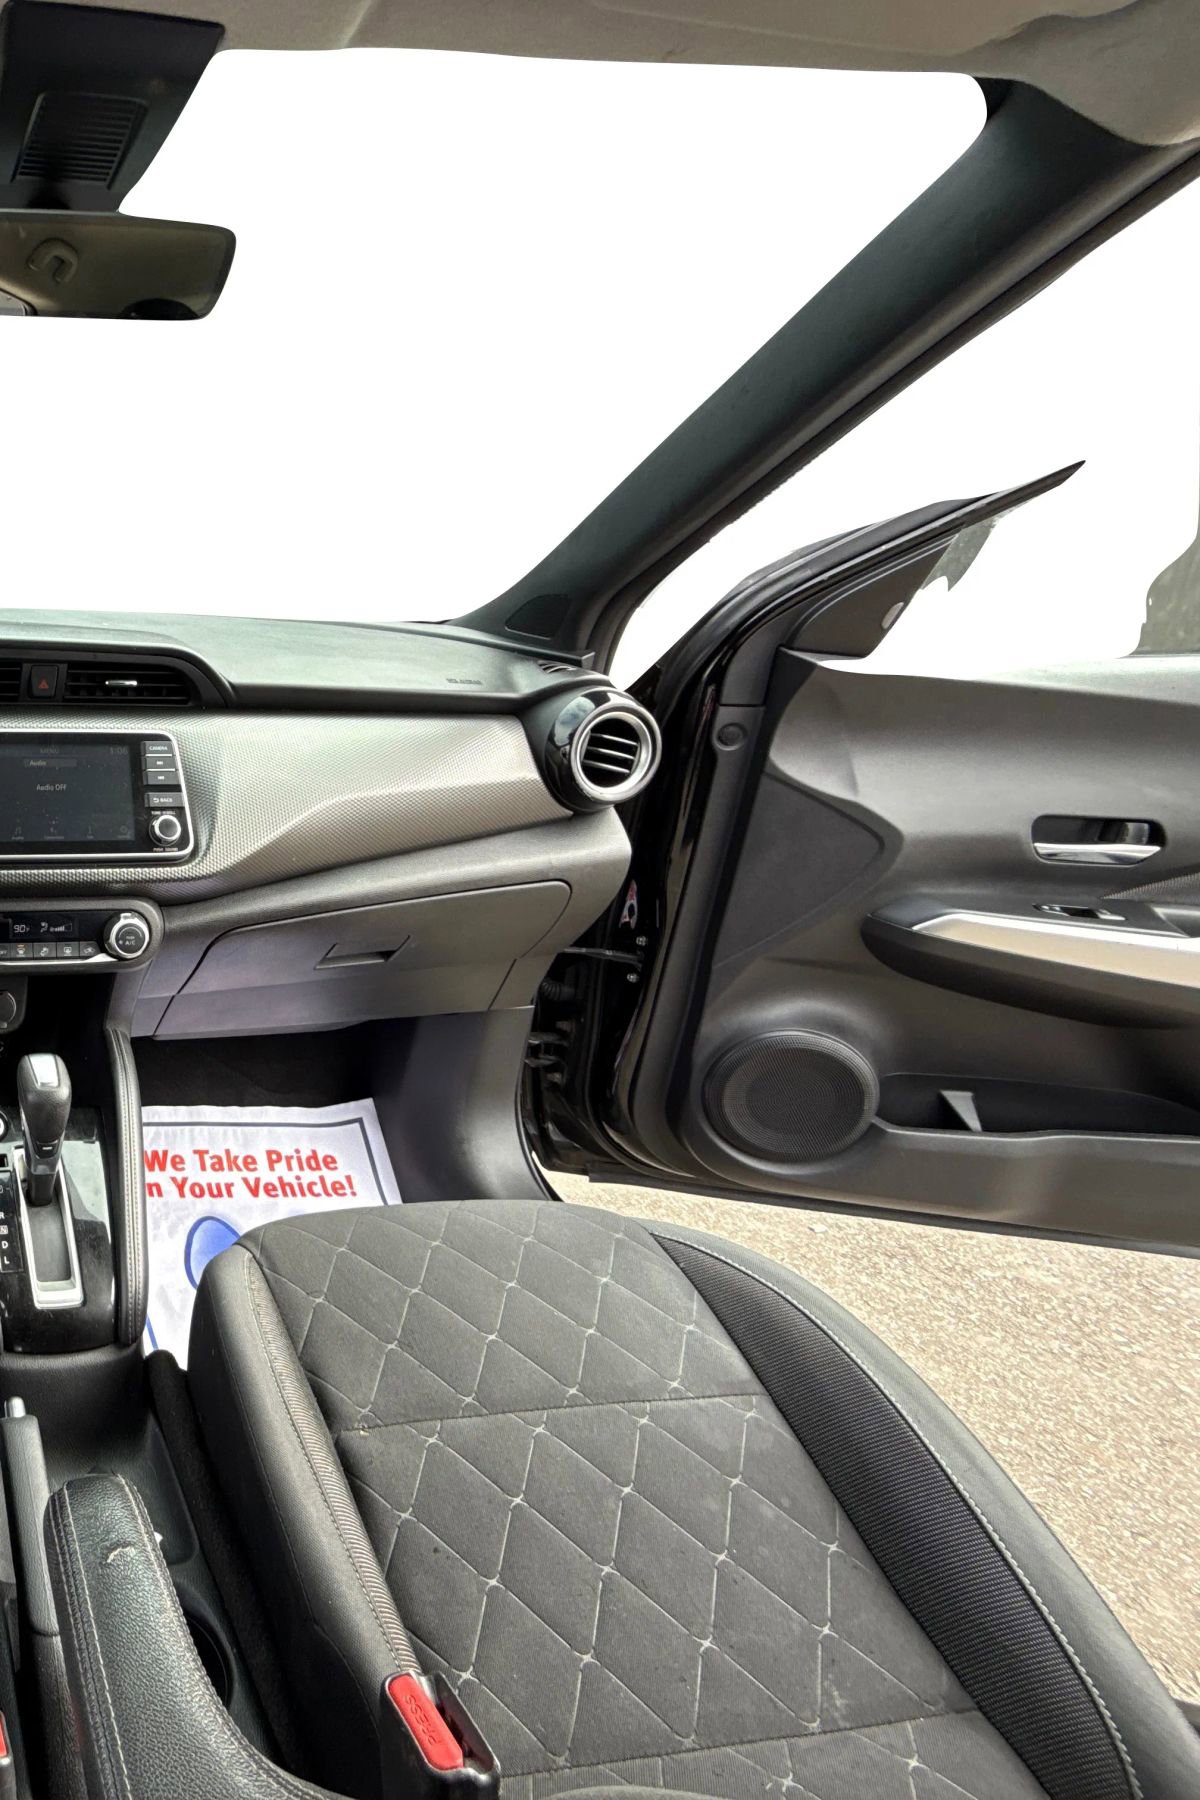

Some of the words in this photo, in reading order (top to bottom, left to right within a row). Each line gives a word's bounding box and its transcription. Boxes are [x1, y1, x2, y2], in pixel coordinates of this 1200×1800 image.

[29, 759, 47, 767] Audio
[36, 783, 54, 792] Audio
[144, 1149, 186, 1172] We
[193, 1148, 258, 1172] Take
[266, 1148, 339, 1172] Pride
[145, 1181, 164, 1198] n
[170, 1176, 235, 1199] Your
[242, 1174, 358, 1198] Vehicle!
[1, 1240, 8, 1249] D
[3, 1255, 10, 1264] L
[404, 1694, 442, 1746] PRESS
